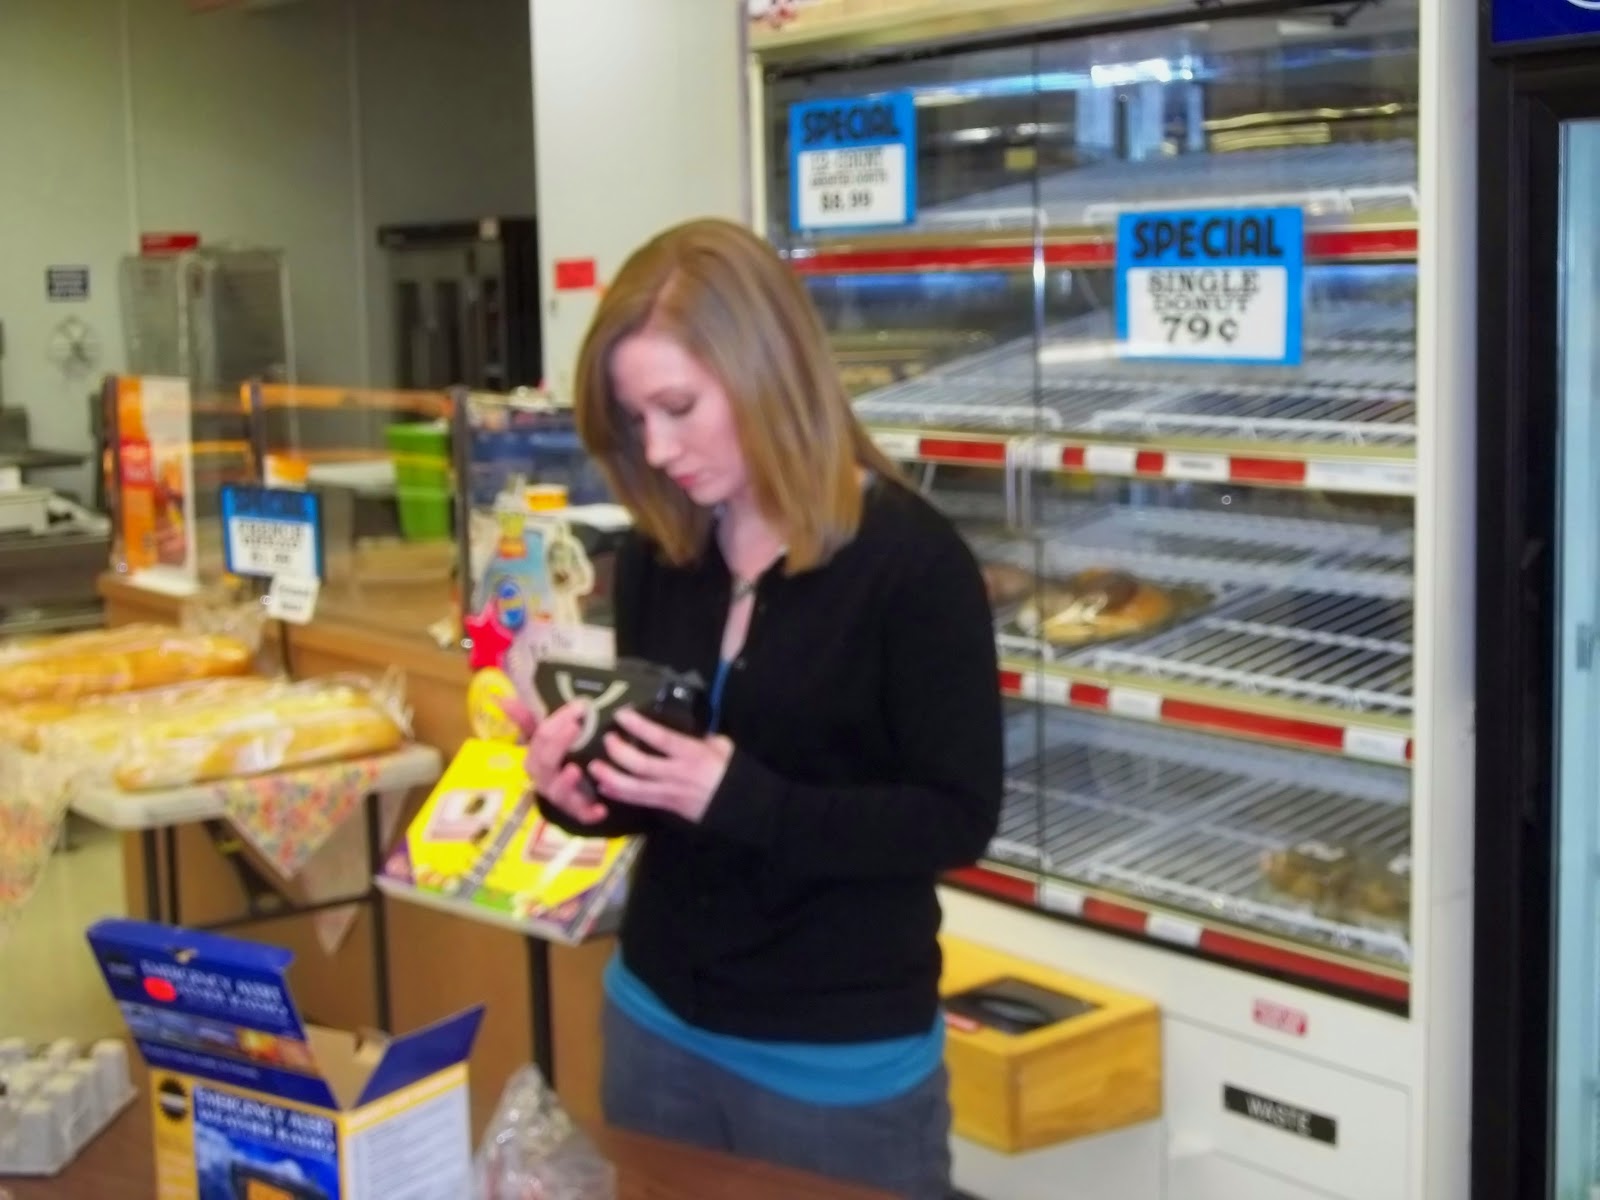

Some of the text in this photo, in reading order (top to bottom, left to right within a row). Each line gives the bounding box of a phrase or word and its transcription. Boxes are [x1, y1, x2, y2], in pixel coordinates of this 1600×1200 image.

[803, 104, 902, 143] SPECIAL
[1132, 216, 1284, 260] SPECIAL
[1148, 269, 1259, 293] SINGLE
[1152, 295, 1252, 313] DONUT
[1161, 315, 1239, 343] 79¢
[1244, 1094, 1313, 1136] WASTE
